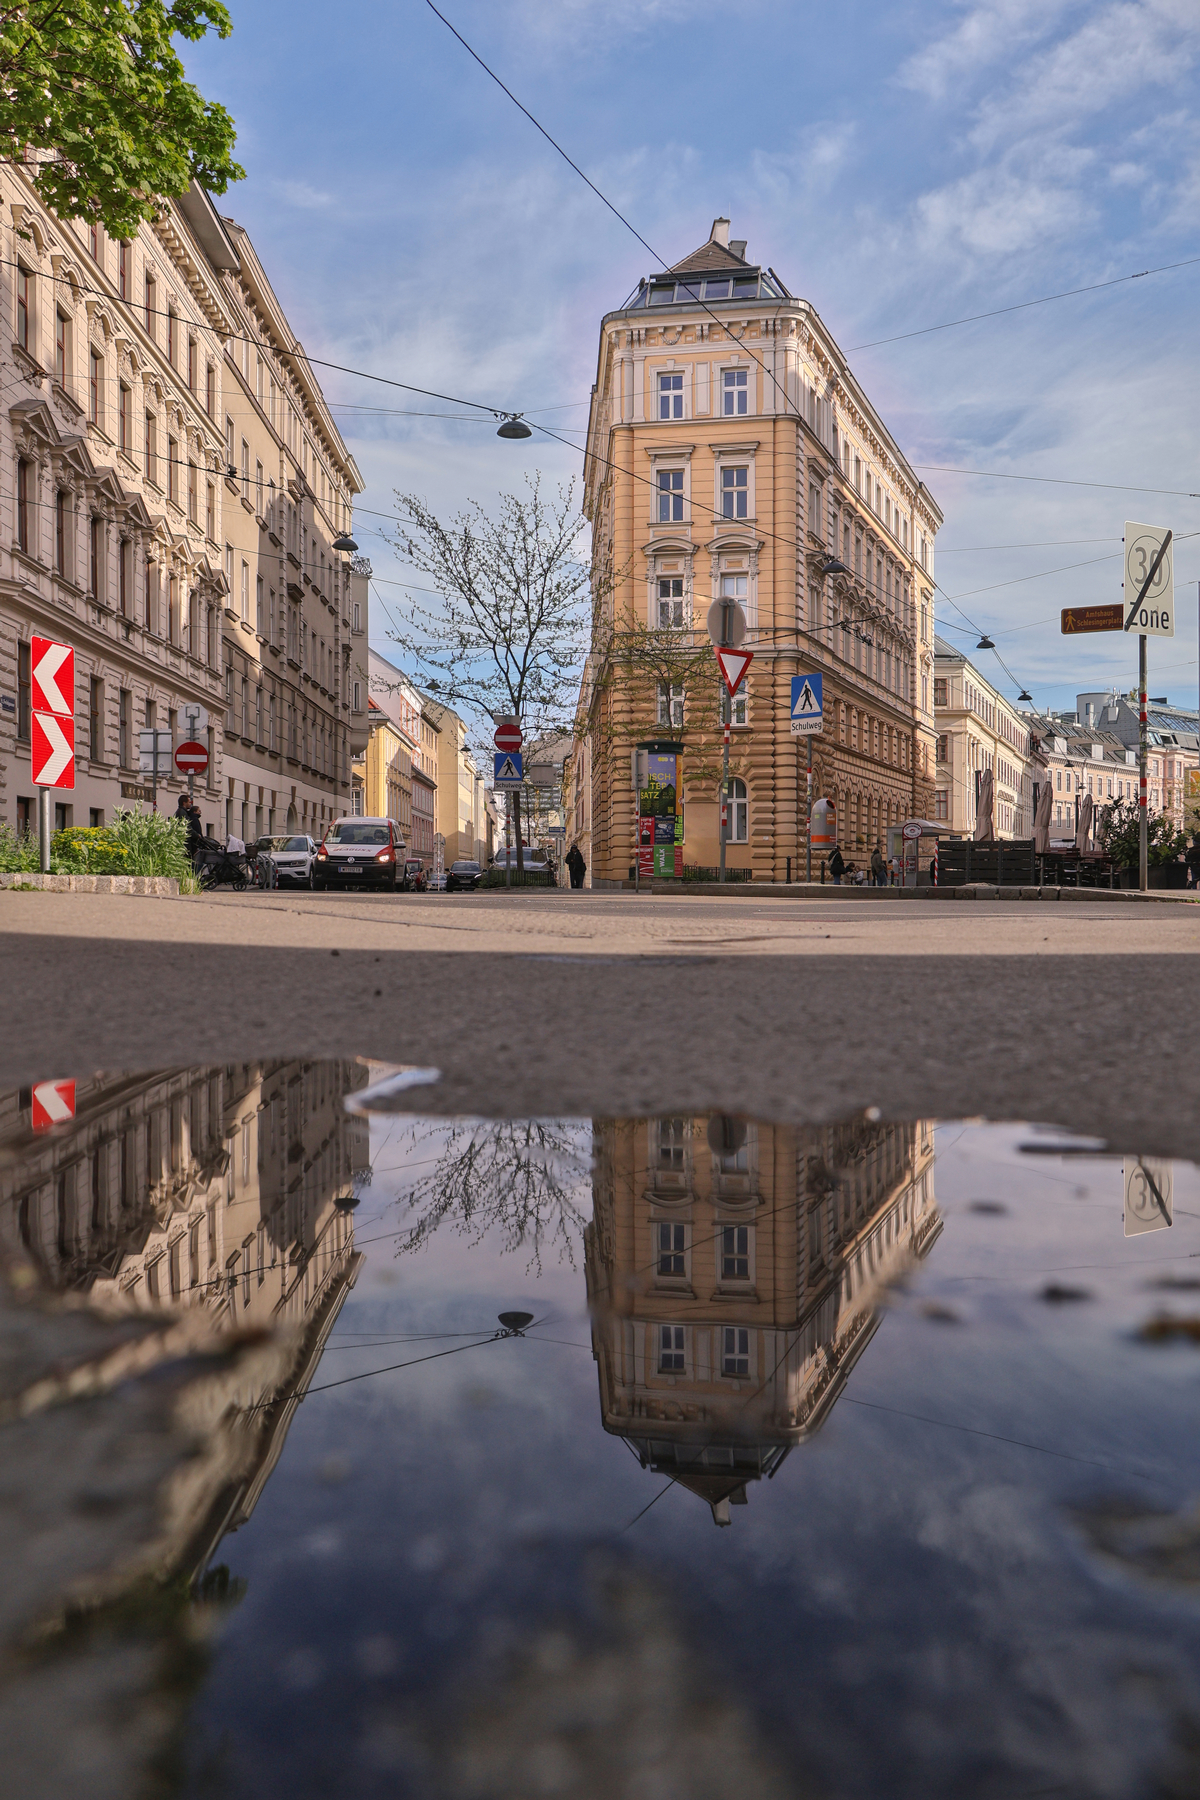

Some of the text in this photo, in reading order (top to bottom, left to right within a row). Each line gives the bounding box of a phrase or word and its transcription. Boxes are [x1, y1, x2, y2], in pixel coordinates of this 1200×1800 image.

[1134, 546, 1163, 587] 30
[1085, 610, 1114, 618] Amtshaus
[1077, 616, 1123, 628] Schlesingerplatz
[791, 721, 822, 731] Schulweg
[495, 781, 522, 790] Schulweg
[640, 791, 660, 800] SATZ
